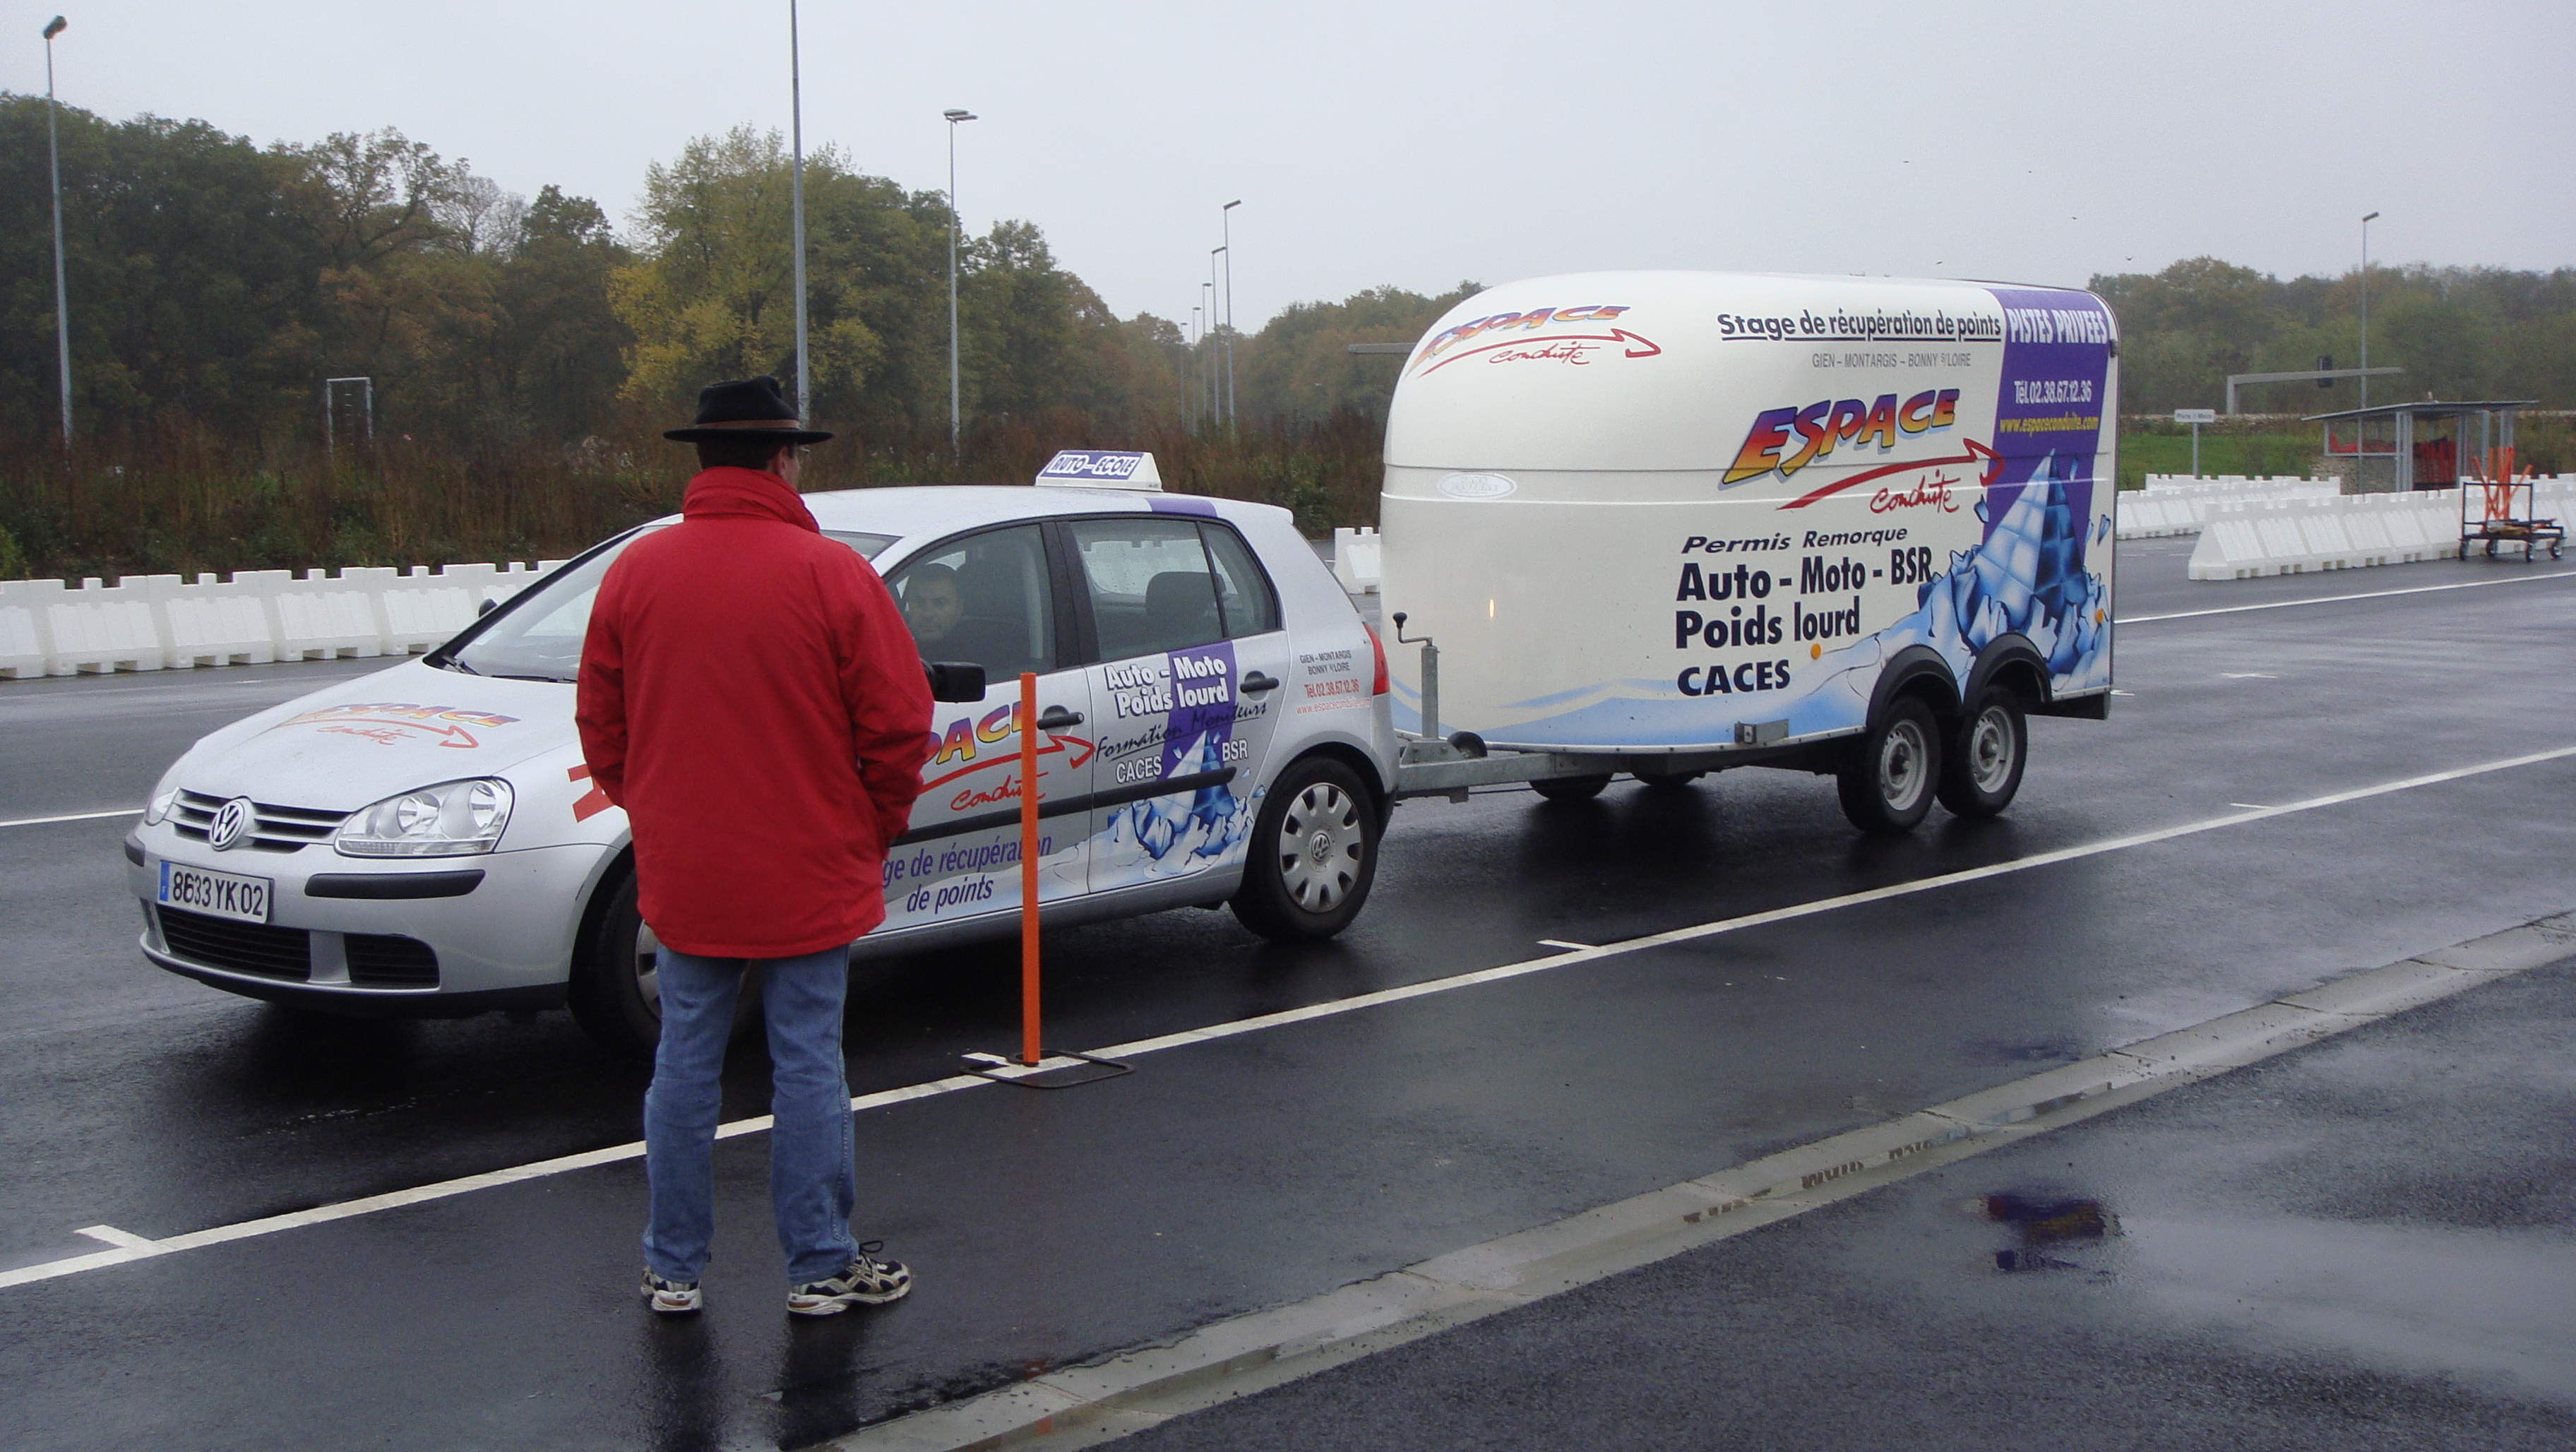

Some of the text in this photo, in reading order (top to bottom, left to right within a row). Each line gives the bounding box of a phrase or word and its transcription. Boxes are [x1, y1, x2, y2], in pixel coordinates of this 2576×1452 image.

[1405, 306, 1630, 376] ESPACE
[1717, 307, 2002, 342] Stage de récupération de points
[2005, 308, 2108, 345] PISTES PRIVEES
[1812, 352, 1835, 368] GIEN
[1844, 352, 1897, 368] MONTARGIS
[1908, 352, 1938, 367] BONNY
[1720, 388, 1960, 487] ESPACE
[1681, 528, 1907, 554] Permis Remorque
[1676, 562, 1771, 601] Auto
[1800, 555, 1866, 594] Moto
[1891, 547, 1932, 585] BSR
[1676, 595, 1859, 648] Poids lourd
[1104, 665, 1155, 691] Auto
[1173, 656, 1227, 680] Moto
[1677, 659, 1790, 696] CACES
[1114, 677, 1229, 718] Poids lourd
[1095, 724, 1181, 763] Formation
[1222, 739, 1248, 762] BSR
[1116, 755, 1162, 784] CACES
[911, 848, 933, 877] de
[907, 874, 994, 915] de points
